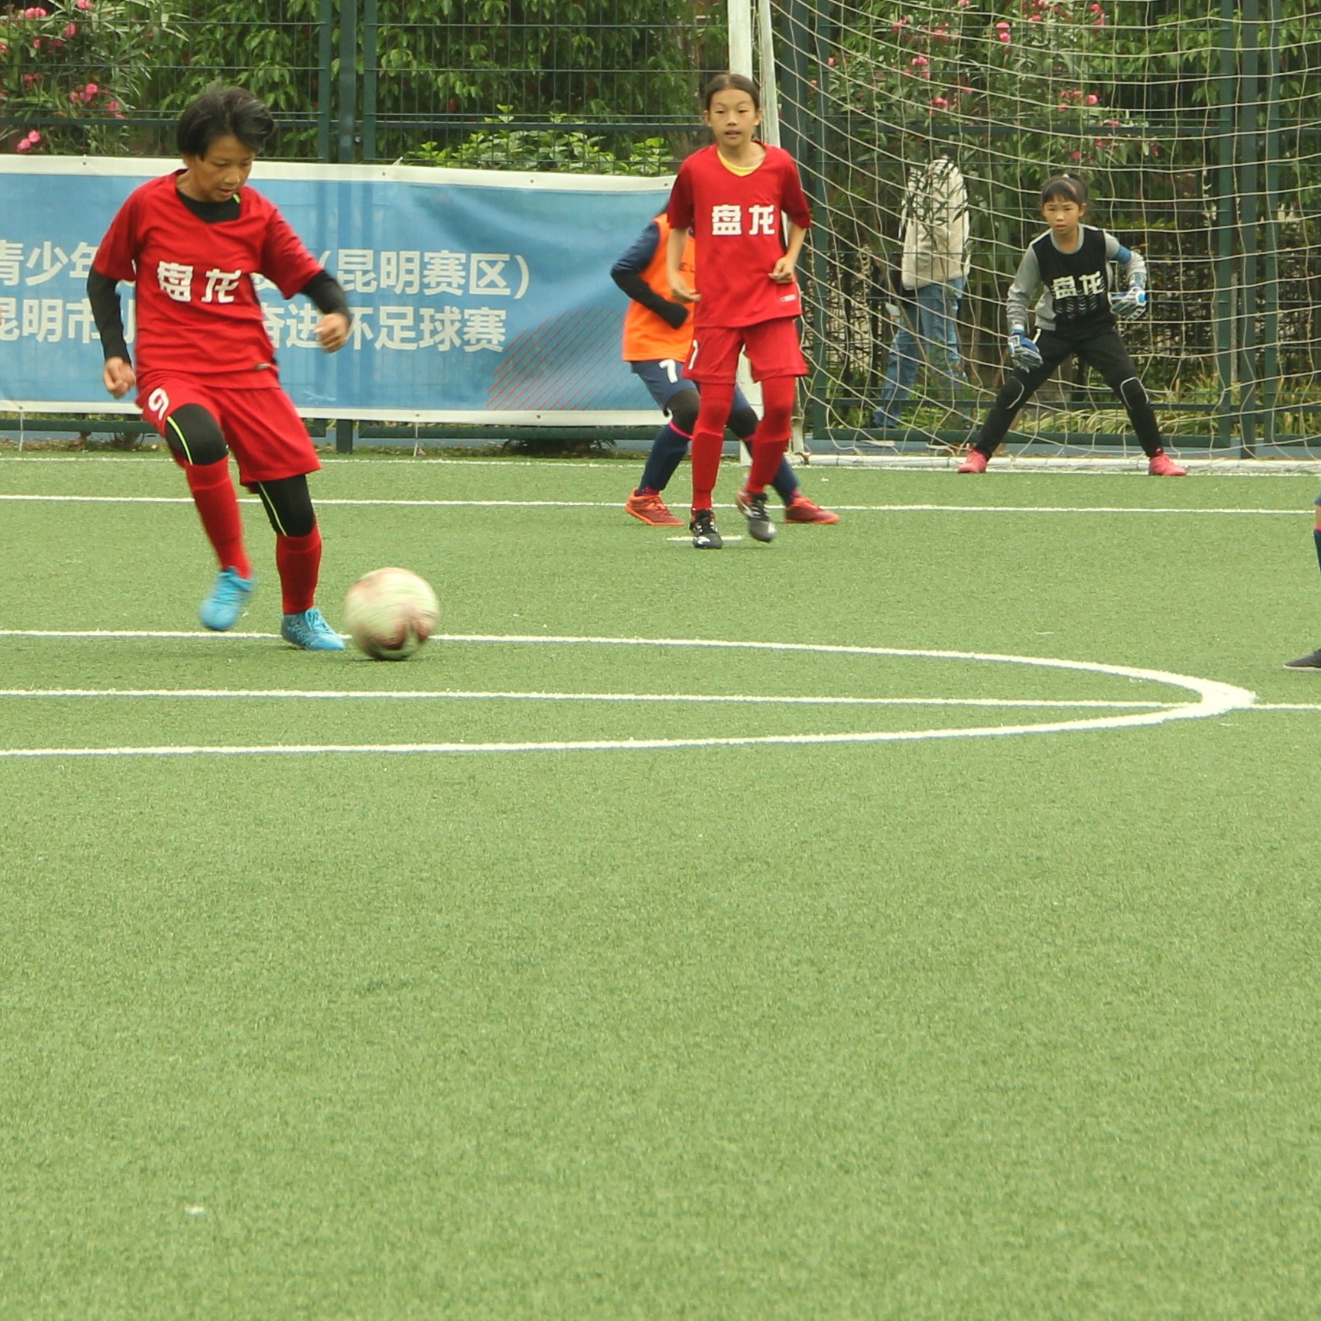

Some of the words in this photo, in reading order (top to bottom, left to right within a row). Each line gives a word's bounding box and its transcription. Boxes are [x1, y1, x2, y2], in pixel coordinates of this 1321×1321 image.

[712, 204, 775, 236] 盘龙
[157, 260, 242, 303] 盘龙
[1052, 271, 1104, 300] 盘龙
[147, 387, 170, 421] 9
